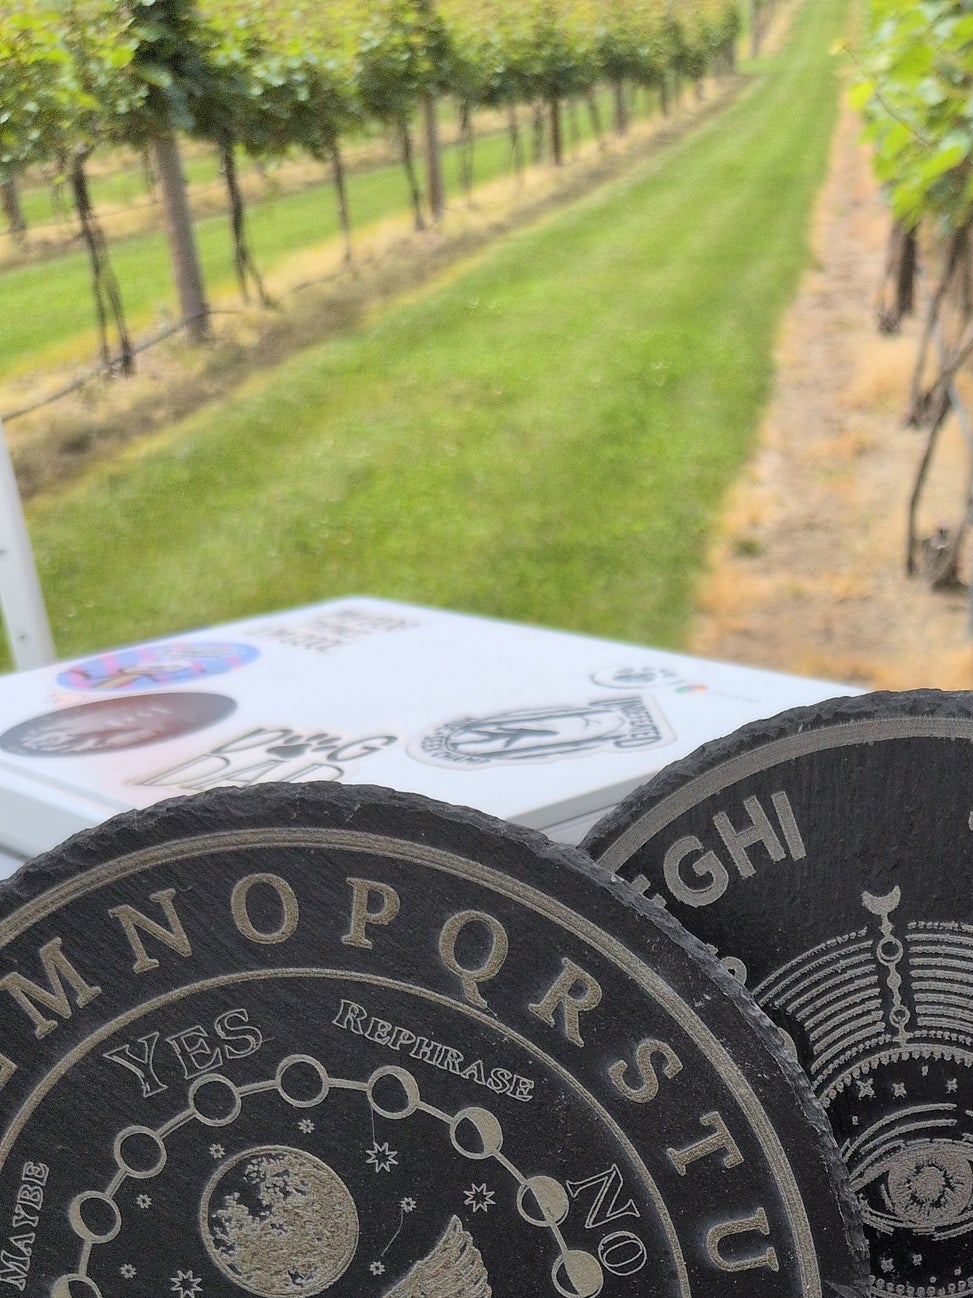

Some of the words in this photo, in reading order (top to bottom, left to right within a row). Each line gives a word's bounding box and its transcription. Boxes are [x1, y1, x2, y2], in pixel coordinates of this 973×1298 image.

[589, 696, 662, 749] UNDEFEATED
[103, 1008, 263, 1098] YES
[332, 999, 535, 1102] REPHRASE
[0, 1160, 50, 1293] MAYBE
[566, 1164, 647, 1276] NO
